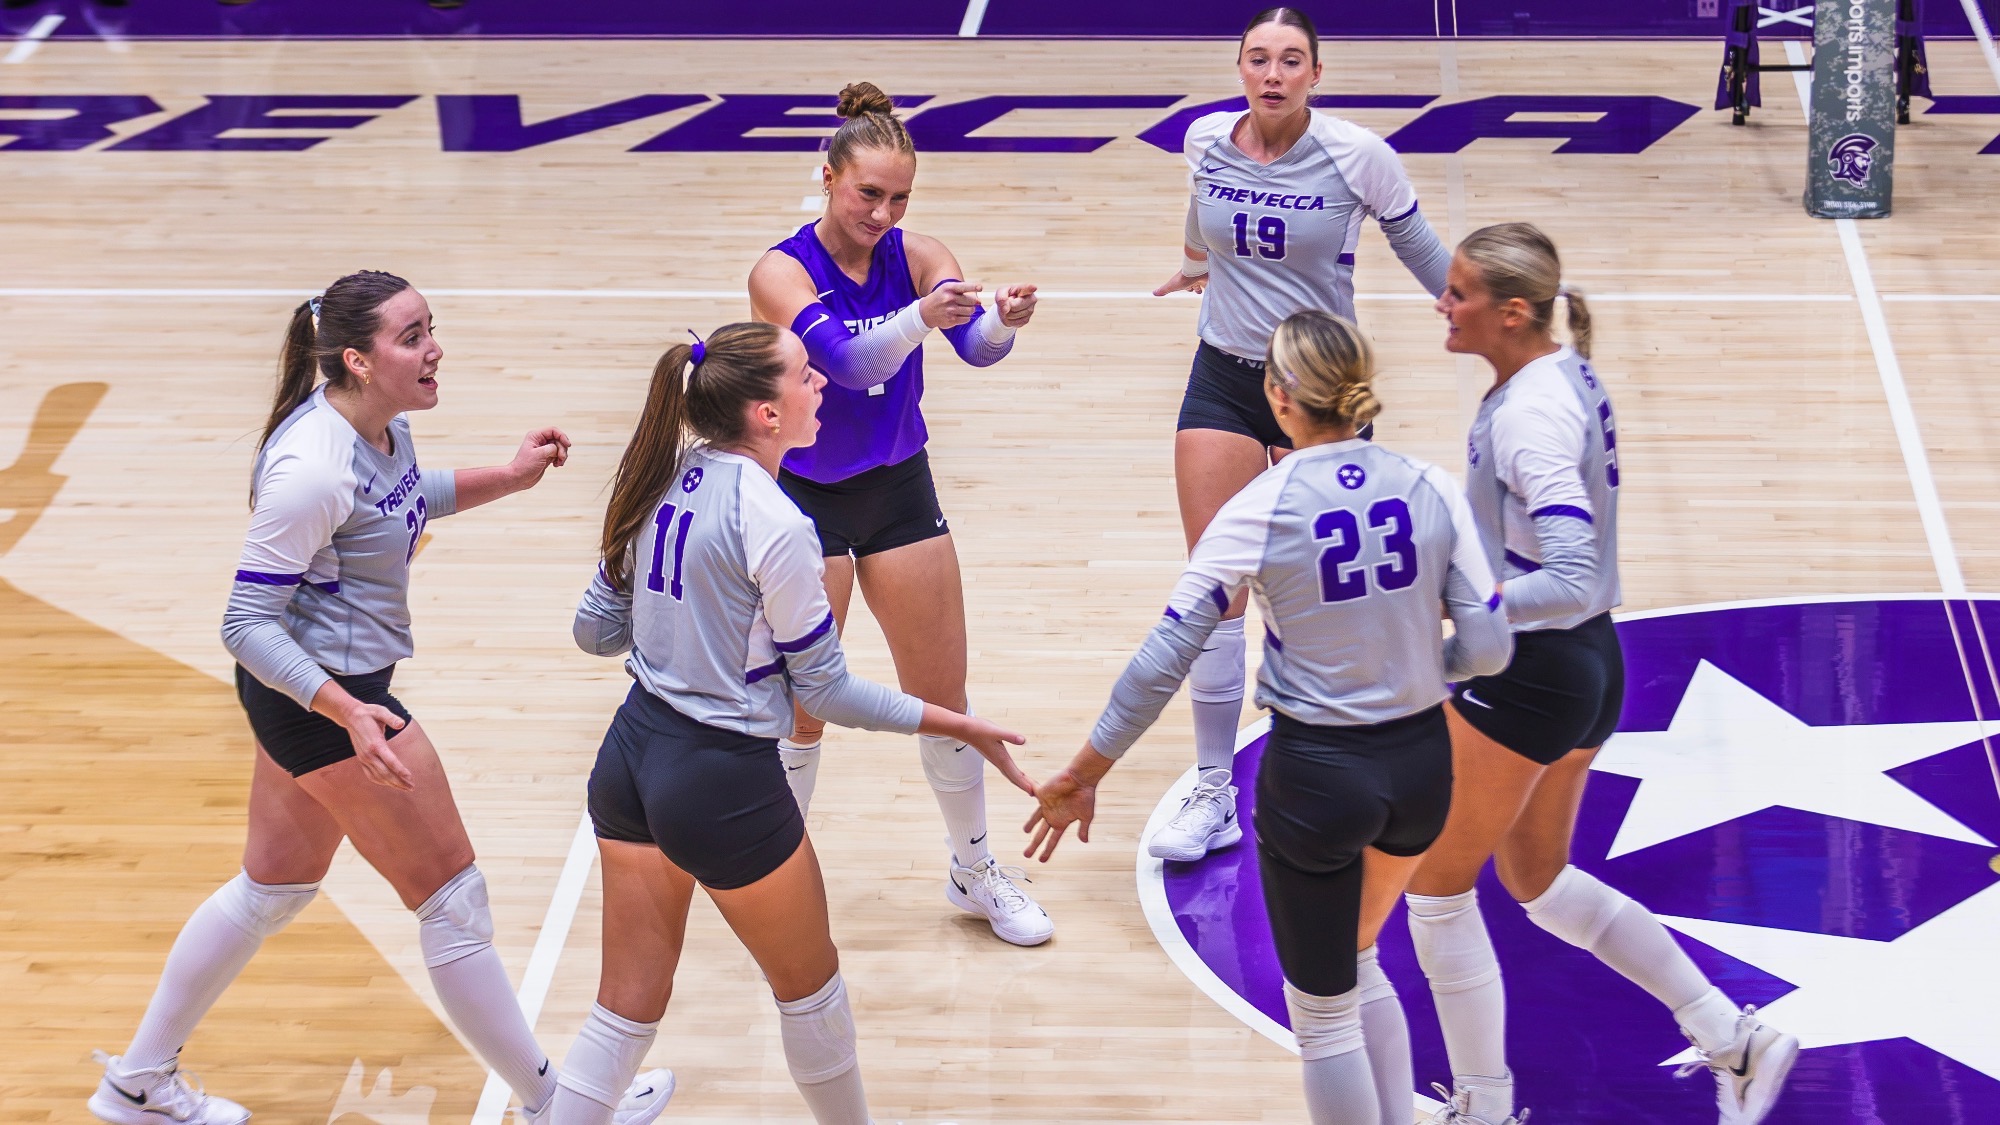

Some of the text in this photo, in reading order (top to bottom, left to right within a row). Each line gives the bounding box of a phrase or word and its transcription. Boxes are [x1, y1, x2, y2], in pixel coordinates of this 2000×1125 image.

[1207, 182, 1325, 211] TREVECCA
[1231, 211, 1287, 262] 19
[646, 501, 697, 604] 11
[1310, 495, 1421, 605] 23
